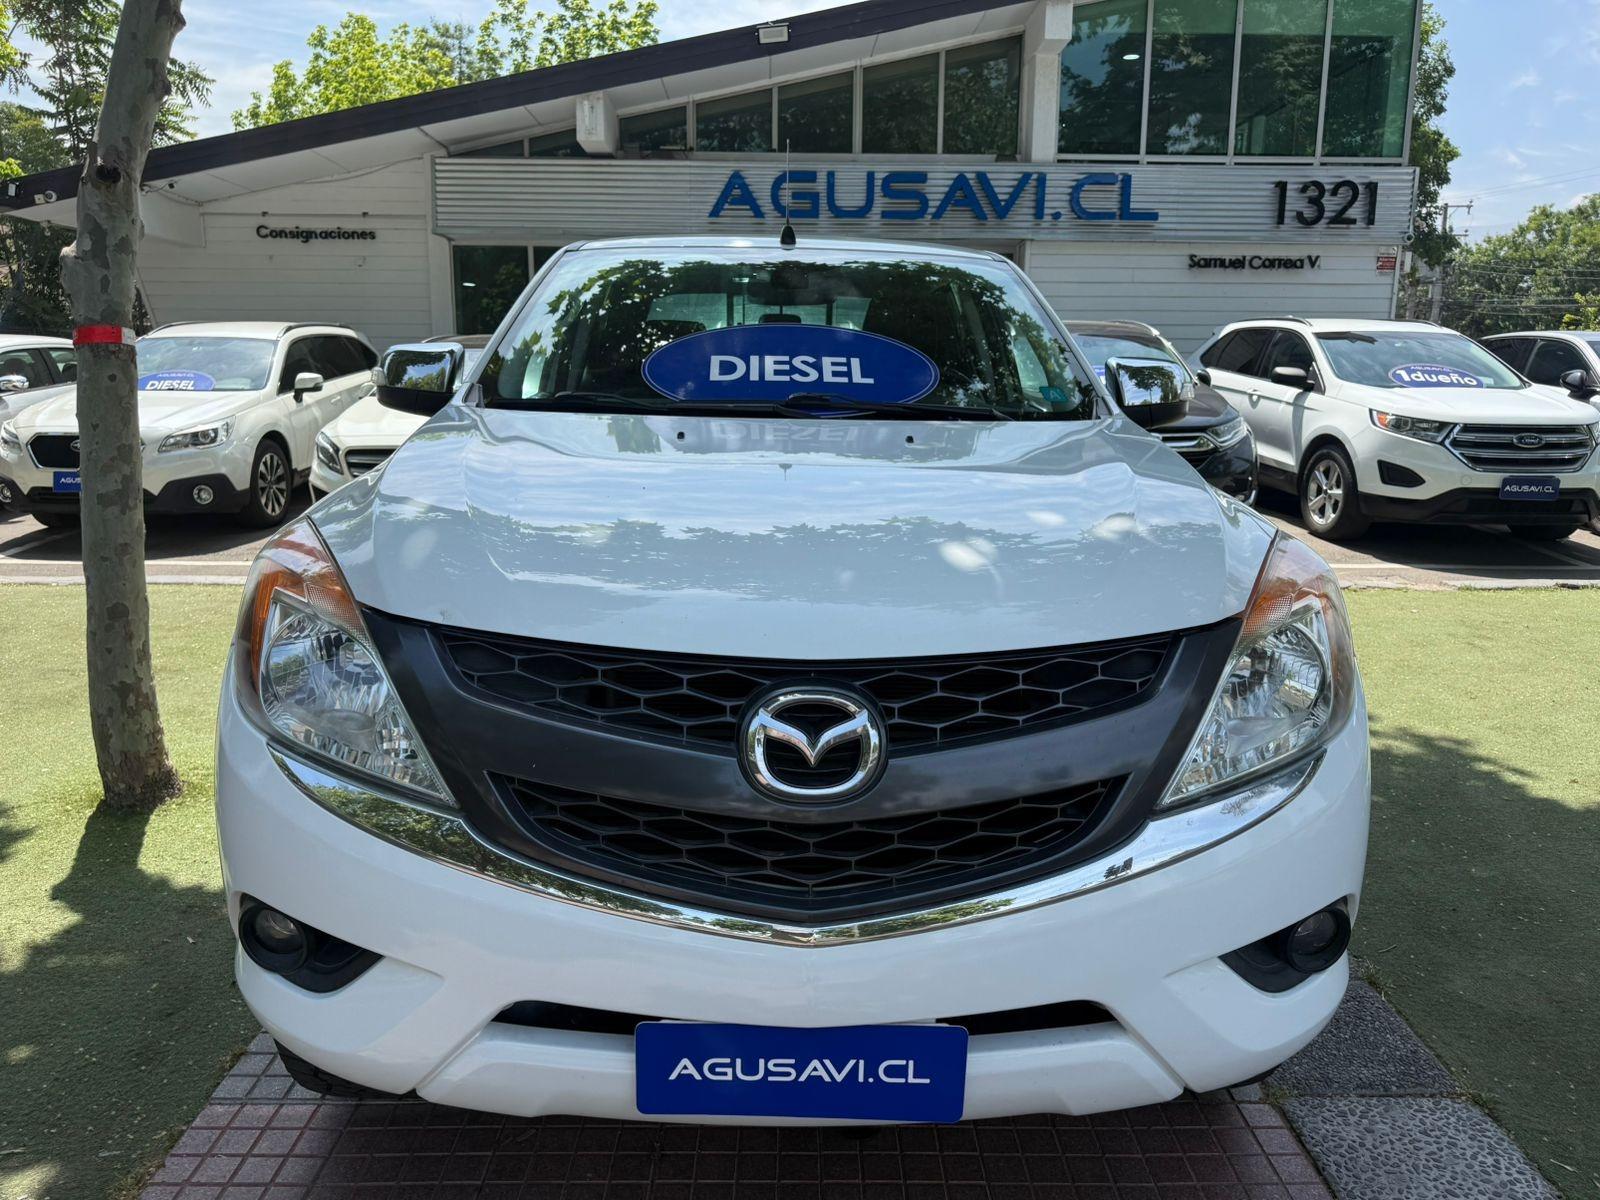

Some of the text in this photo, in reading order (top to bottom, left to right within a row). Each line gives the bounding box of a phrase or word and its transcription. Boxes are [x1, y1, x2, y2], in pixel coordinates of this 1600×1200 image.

[708, 170, 1159, 221] AGUSAVI.CL
[1273, 180, 1379, 226] 1321
[256, 225, 376, 243] Consignaciones
[1188, 254, 1246, 270] Samuel
[1249, 255, 1304, 270] Correa
[709, 354, 875, 384] DIESEL
[1396, 369, 1478, 386] 1dueño
[145, 380, 195, 390] DIESEL
[1503, 484, 1555, 493] AGUSAVI.CL
[668, 1058, 931, 1084] AGUSAVI.CL
